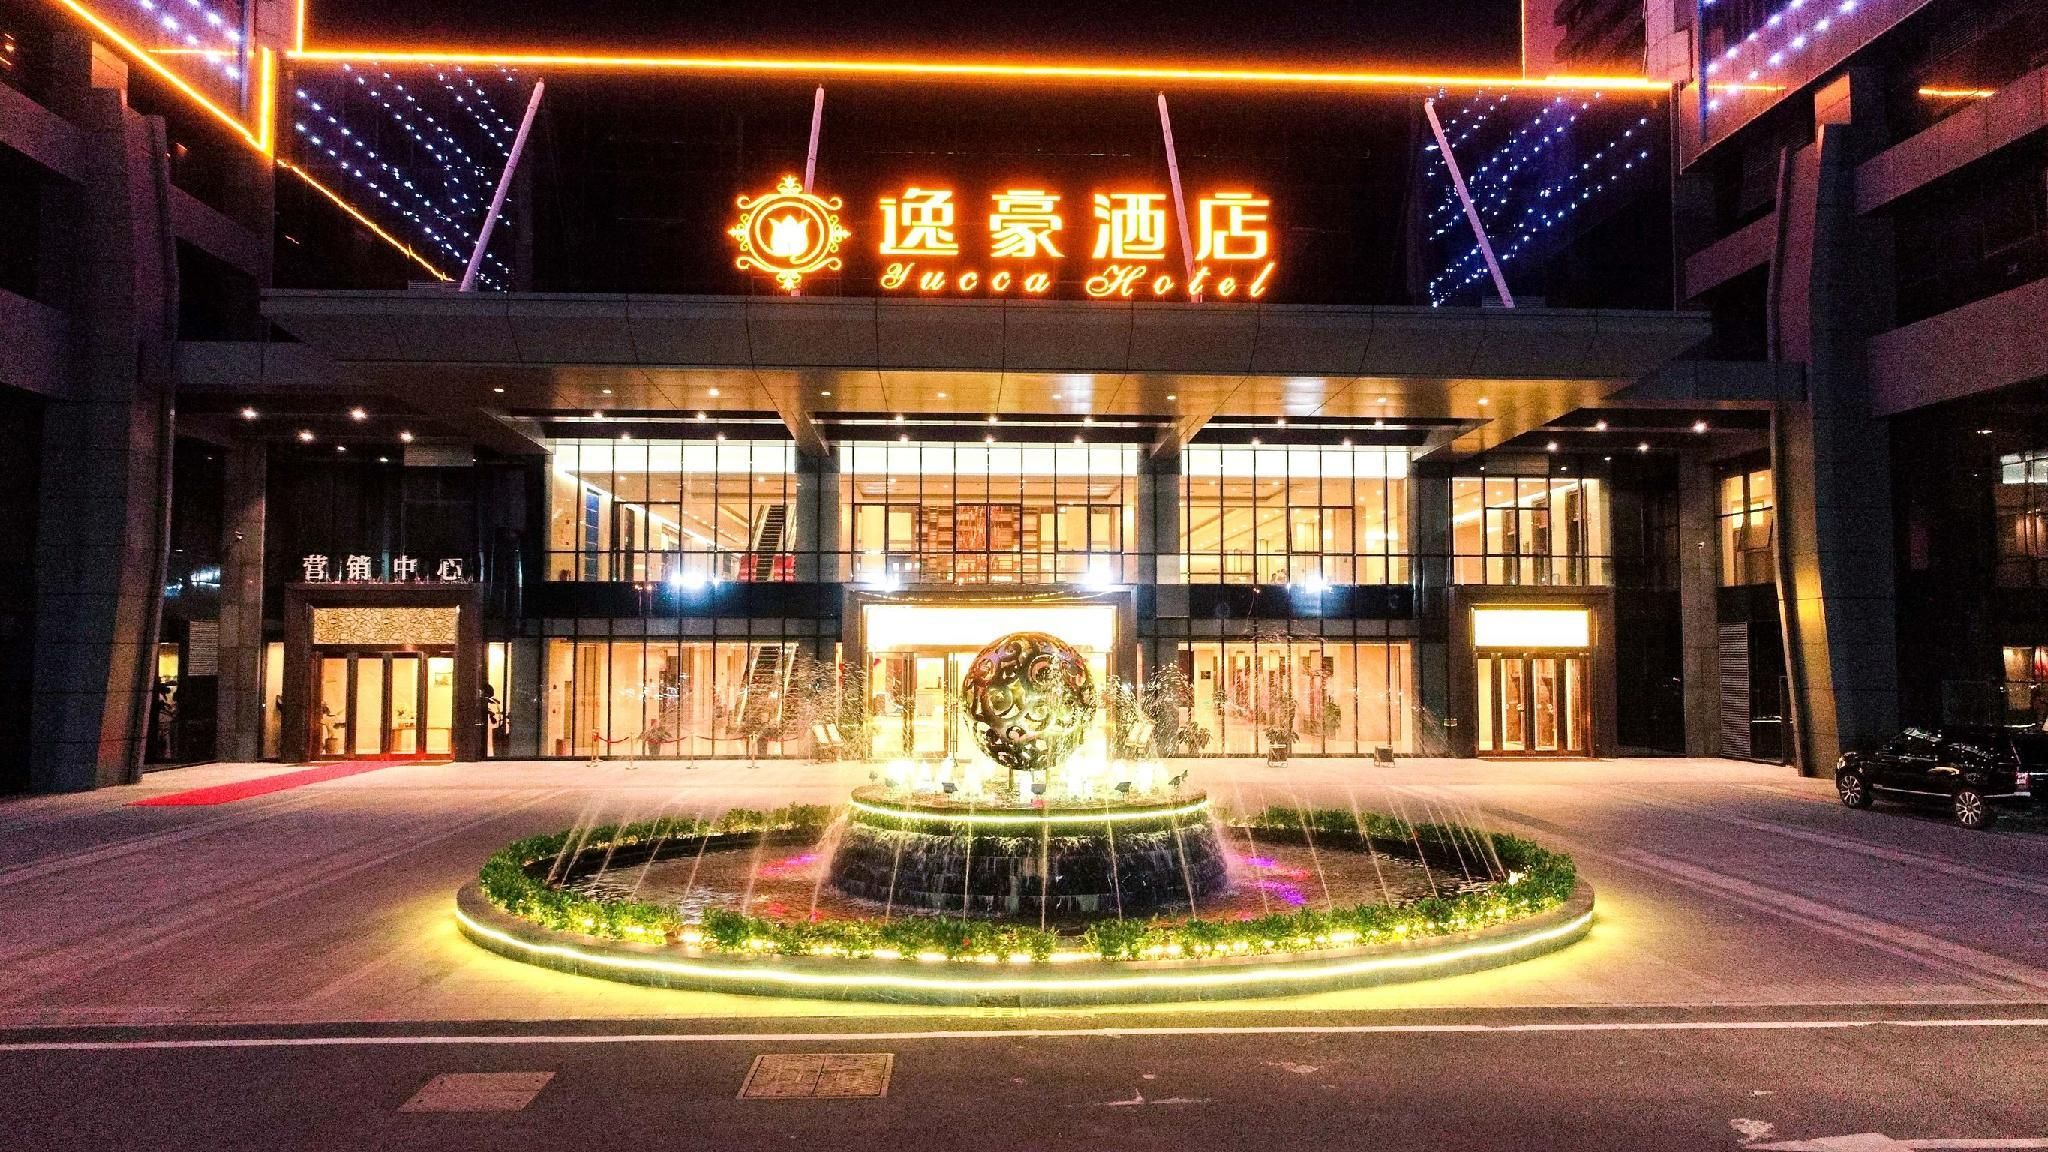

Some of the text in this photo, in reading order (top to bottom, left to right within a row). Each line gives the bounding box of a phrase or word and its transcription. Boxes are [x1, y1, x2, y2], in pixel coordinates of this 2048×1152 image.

[879, 187, 1271, 261] 逸豪酒店
[880, 262, 1276, 298] Yucca Hotel
[302, 554, 462, 580] 营销中心
